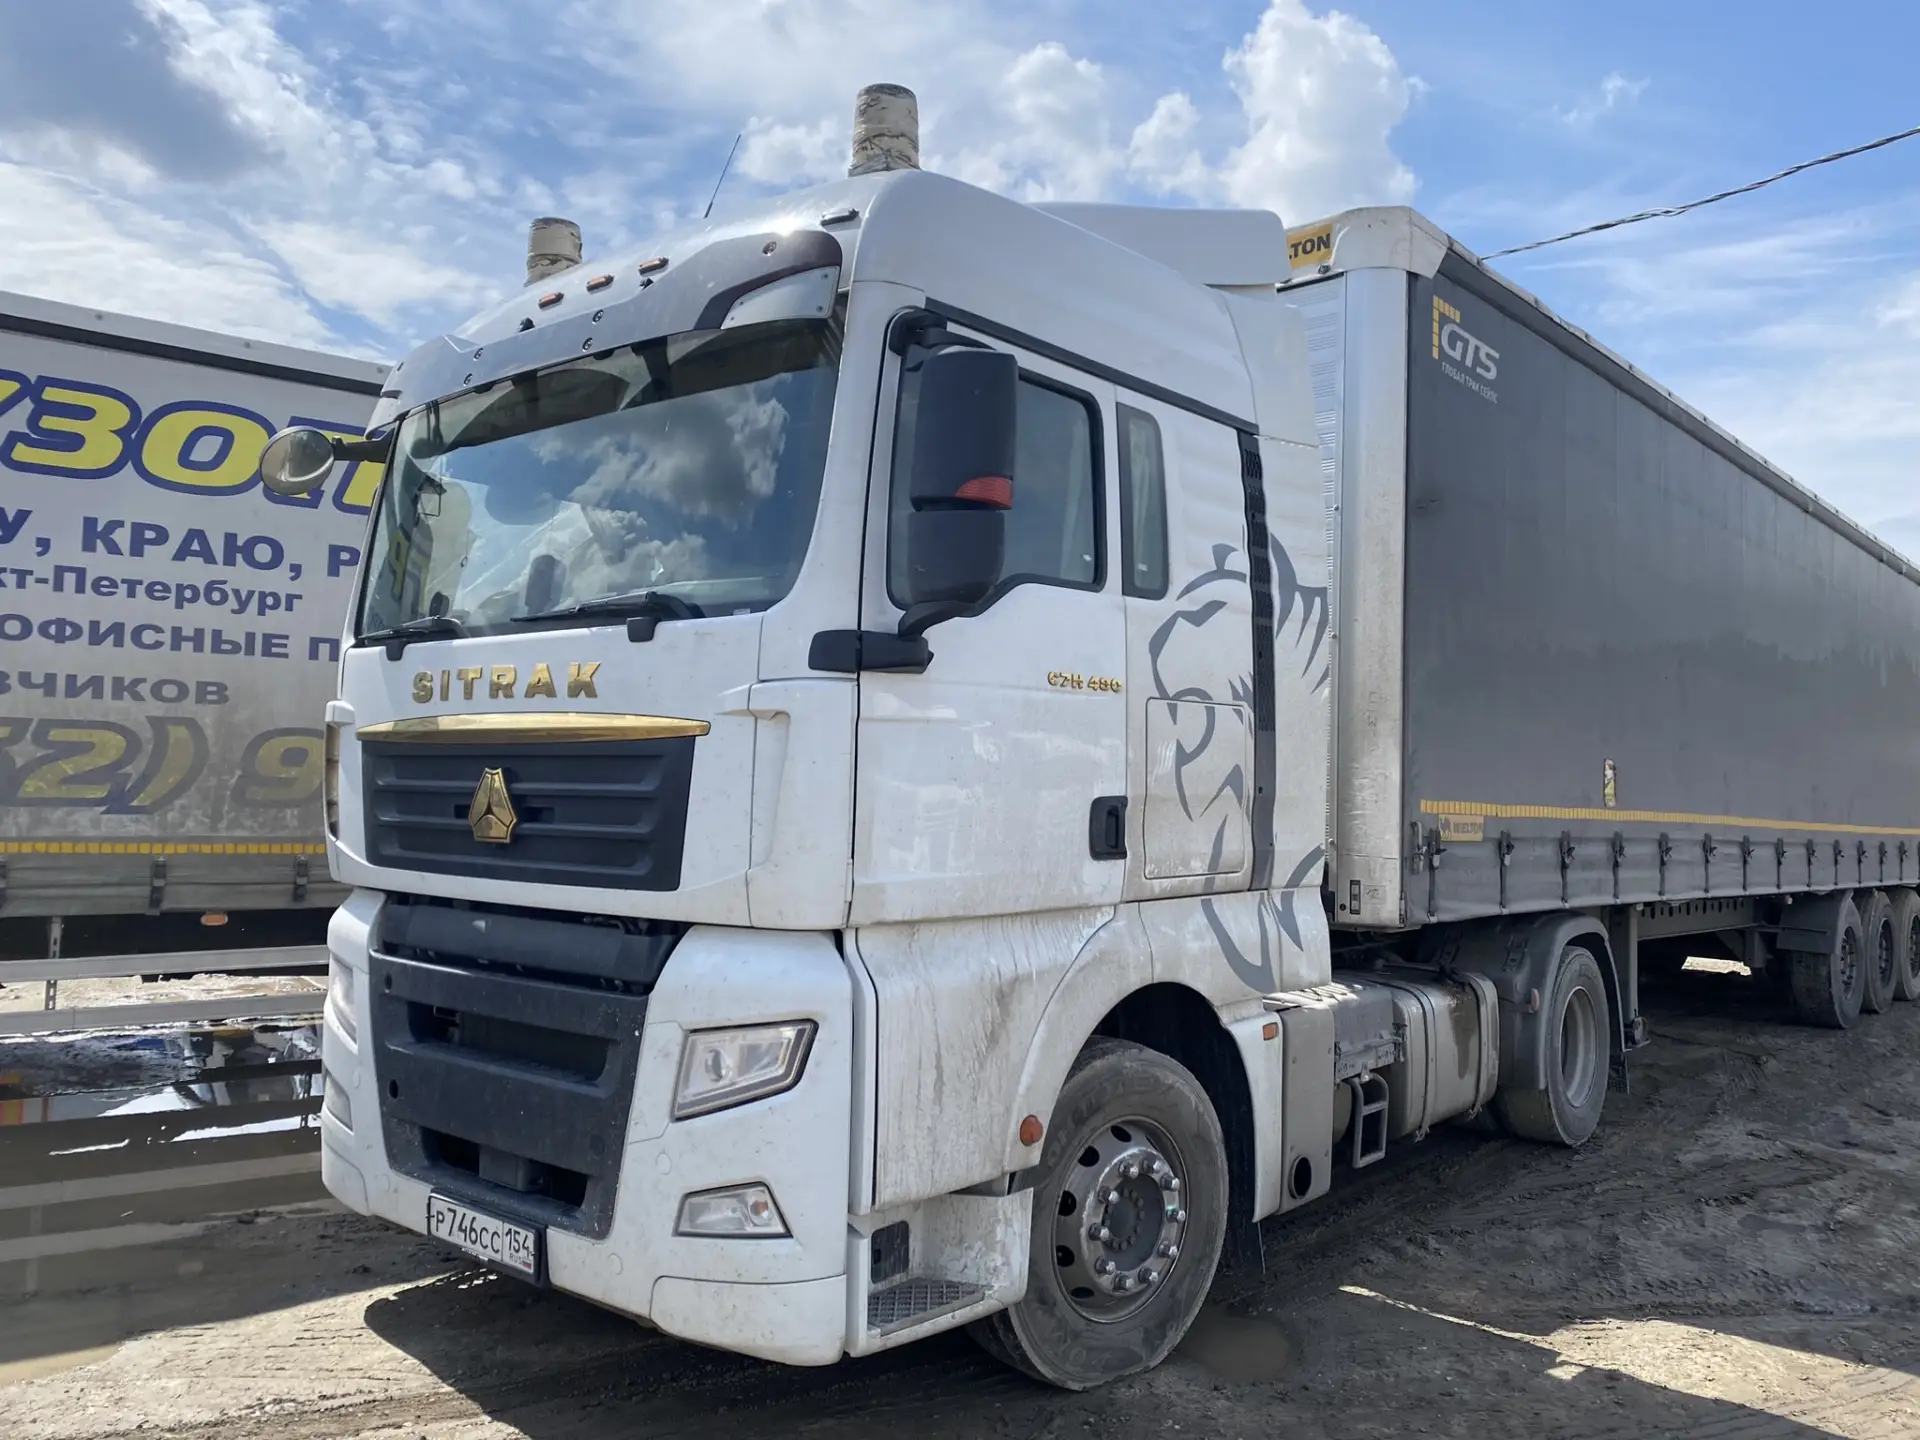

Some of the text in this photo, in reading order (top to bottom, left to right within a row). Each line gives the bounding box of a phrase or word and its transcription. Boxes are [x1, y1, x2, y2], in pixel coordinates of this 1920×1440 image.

[1289, 232, 1331, 260] TON
[1441, 323, 1500, 380] GTS
[81, 516, 302, 581] КРАЮ,
[0, 613, 289, 659] ОФИСНЫЕ
[412, 660, 602, 704] SITRAK
[1047, 671, 1084, 690] C7H
